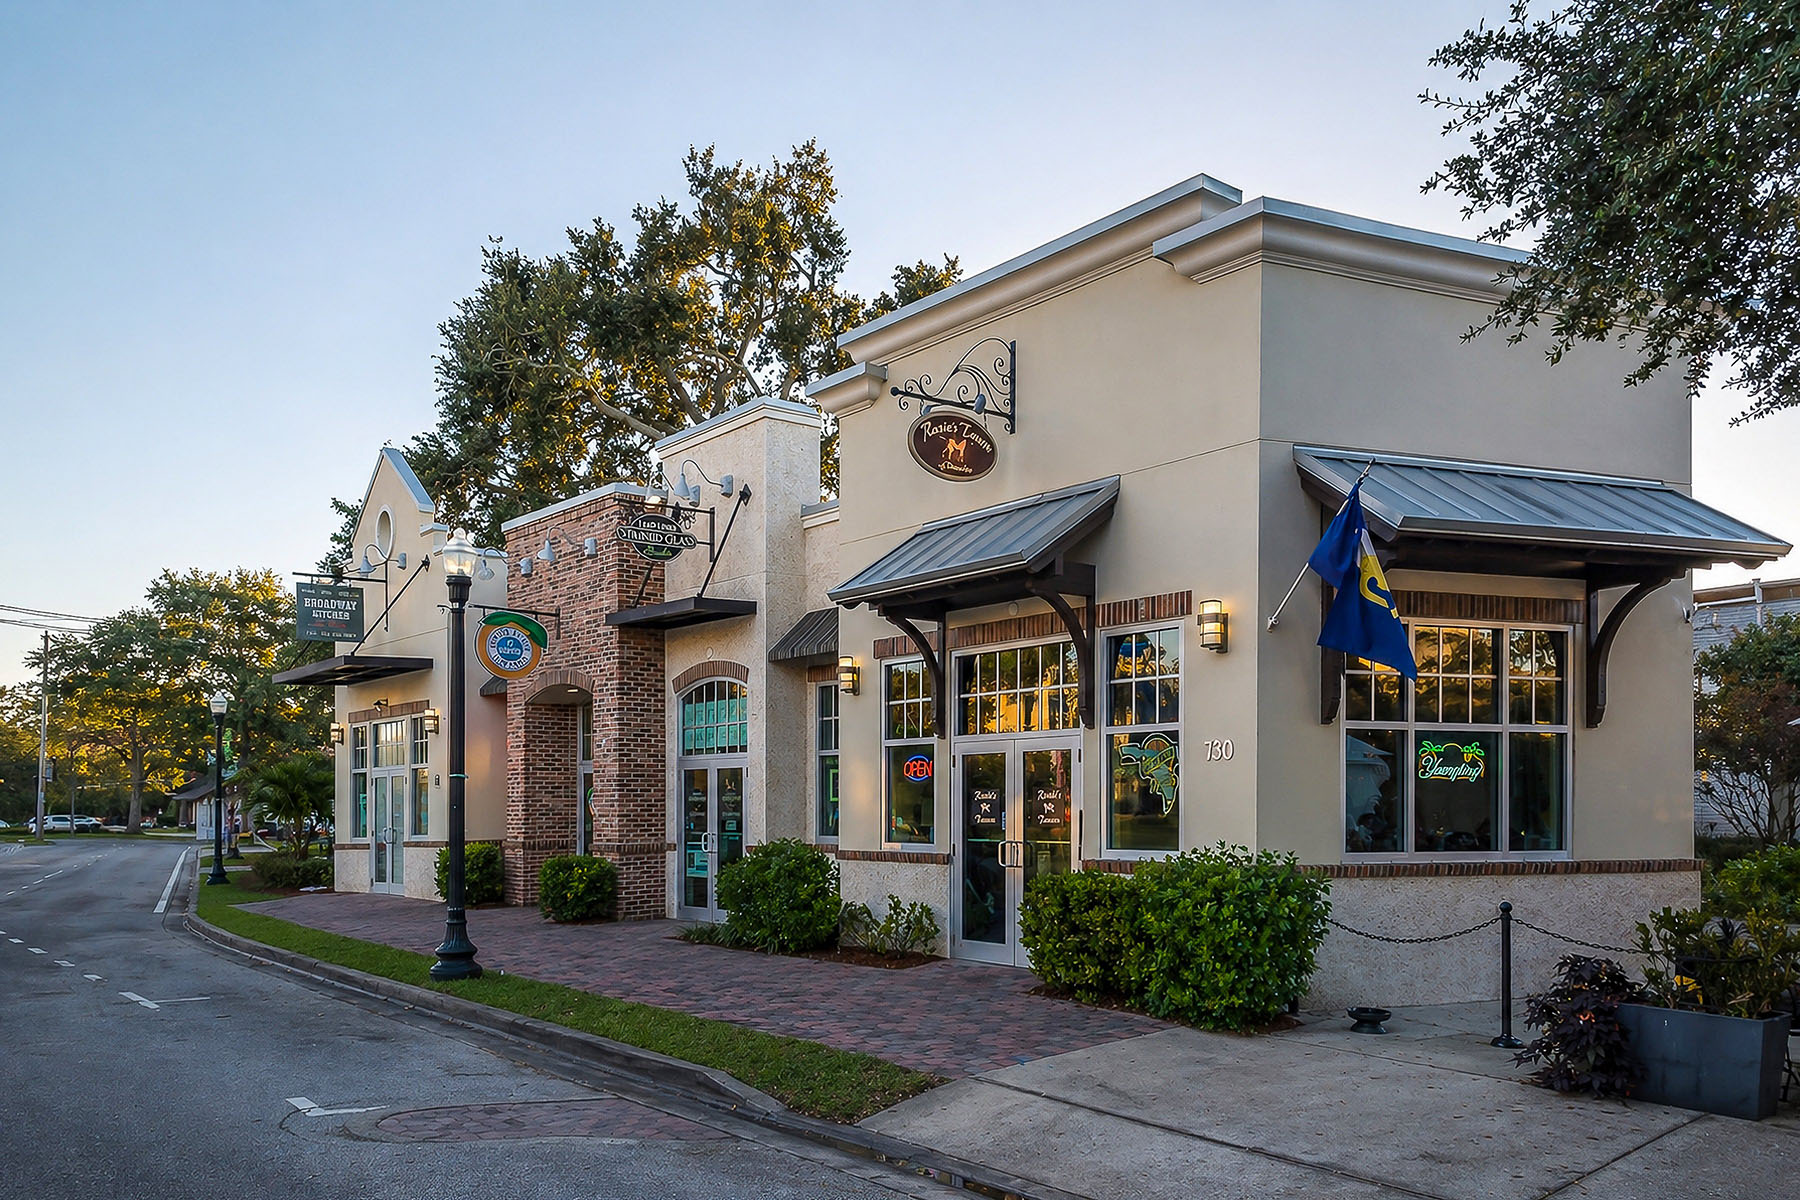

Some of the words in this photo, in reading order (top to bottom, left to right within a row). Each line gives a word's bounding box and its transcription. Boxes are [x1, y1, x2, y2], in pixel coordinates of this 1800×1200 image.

[303, 597, 357, 610] BROADWAY
[1204, 739, 1234, 761] 730
[903, 760, 933, 777] OPEN
